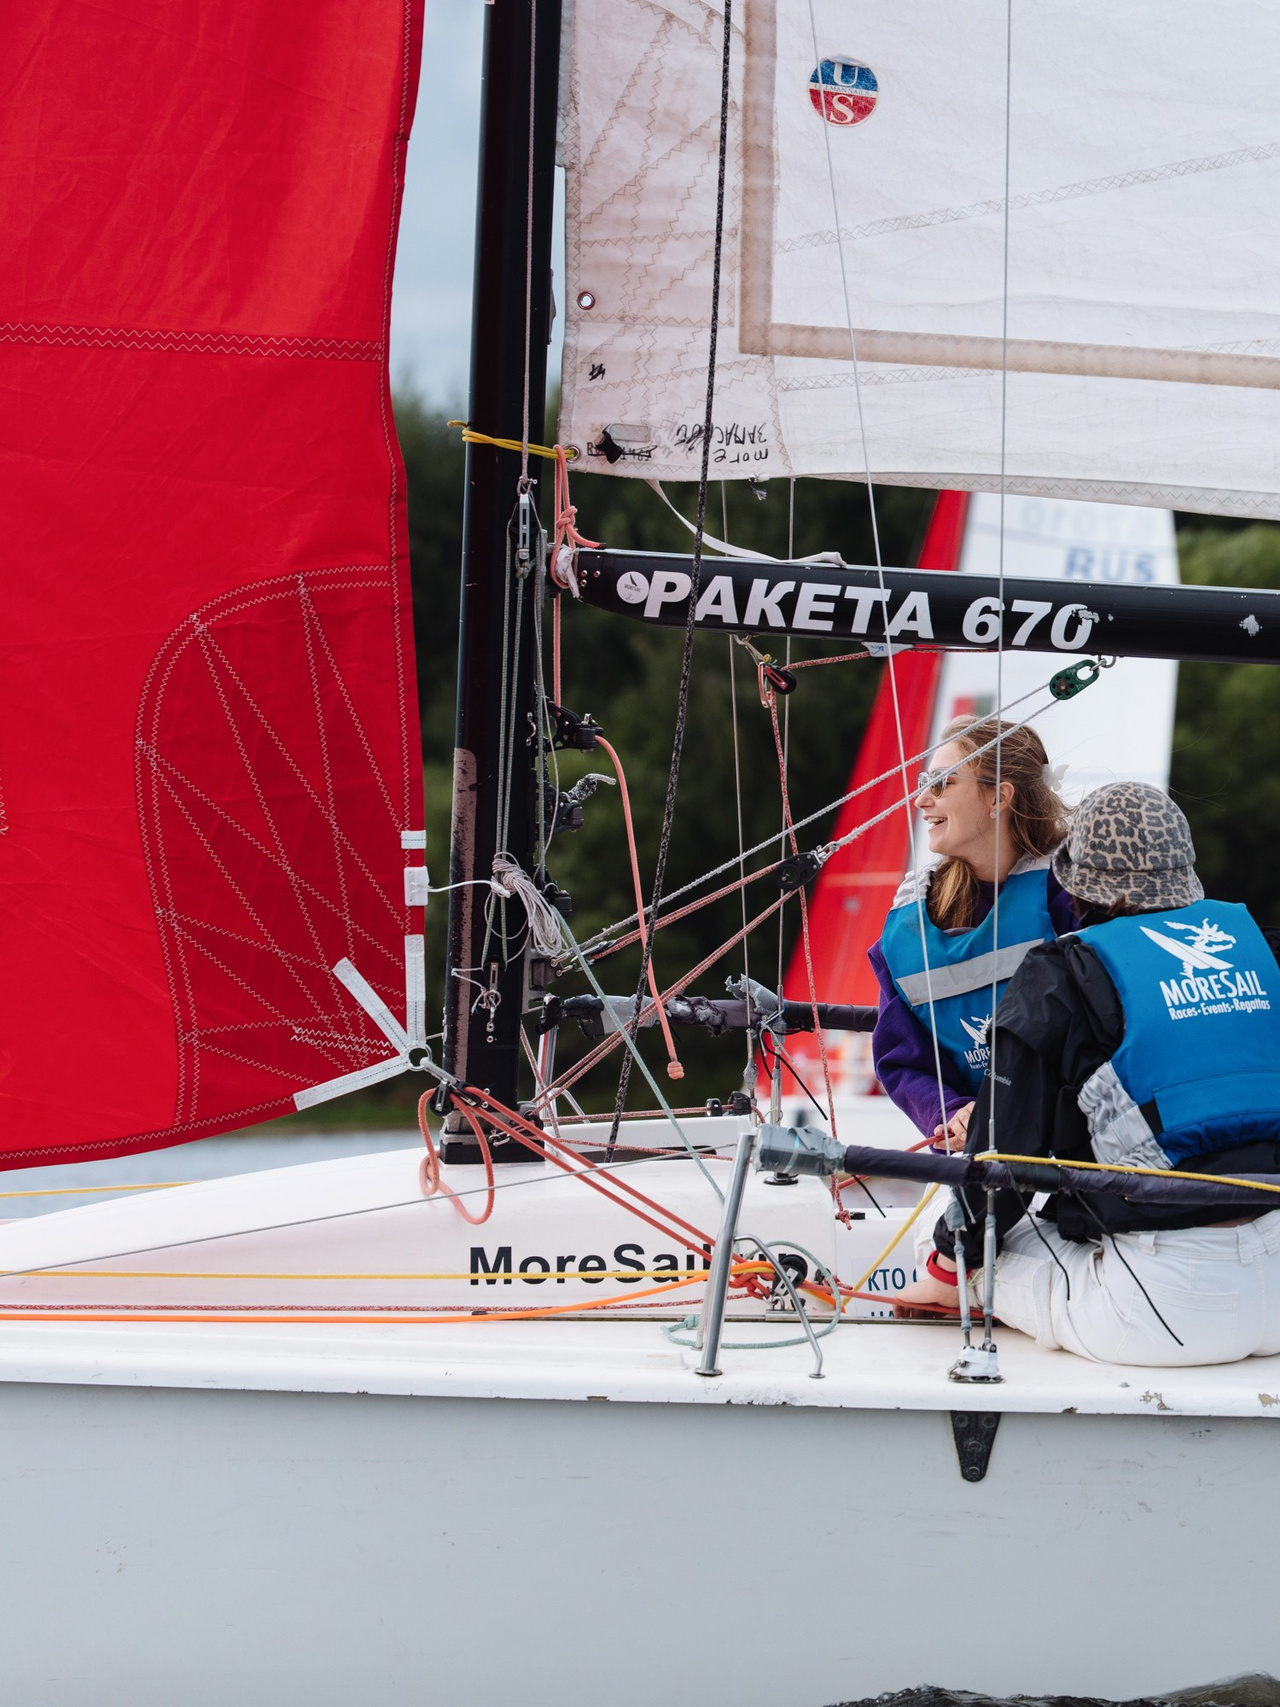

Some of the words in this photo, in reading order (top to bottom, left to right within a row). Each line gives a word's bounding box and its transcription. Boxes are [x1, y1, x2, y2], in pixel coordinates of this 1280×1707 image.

[829, 94, 854, 124] S
[1064, 548, 1156, 582] RUS
[644, 571, 935, 640] РАКЕТА
[962, 597, 1095, 650] 670
[1159, 970, 1268, 1008] MORESAIL
[868, 1268, 906, 1291] КТО
